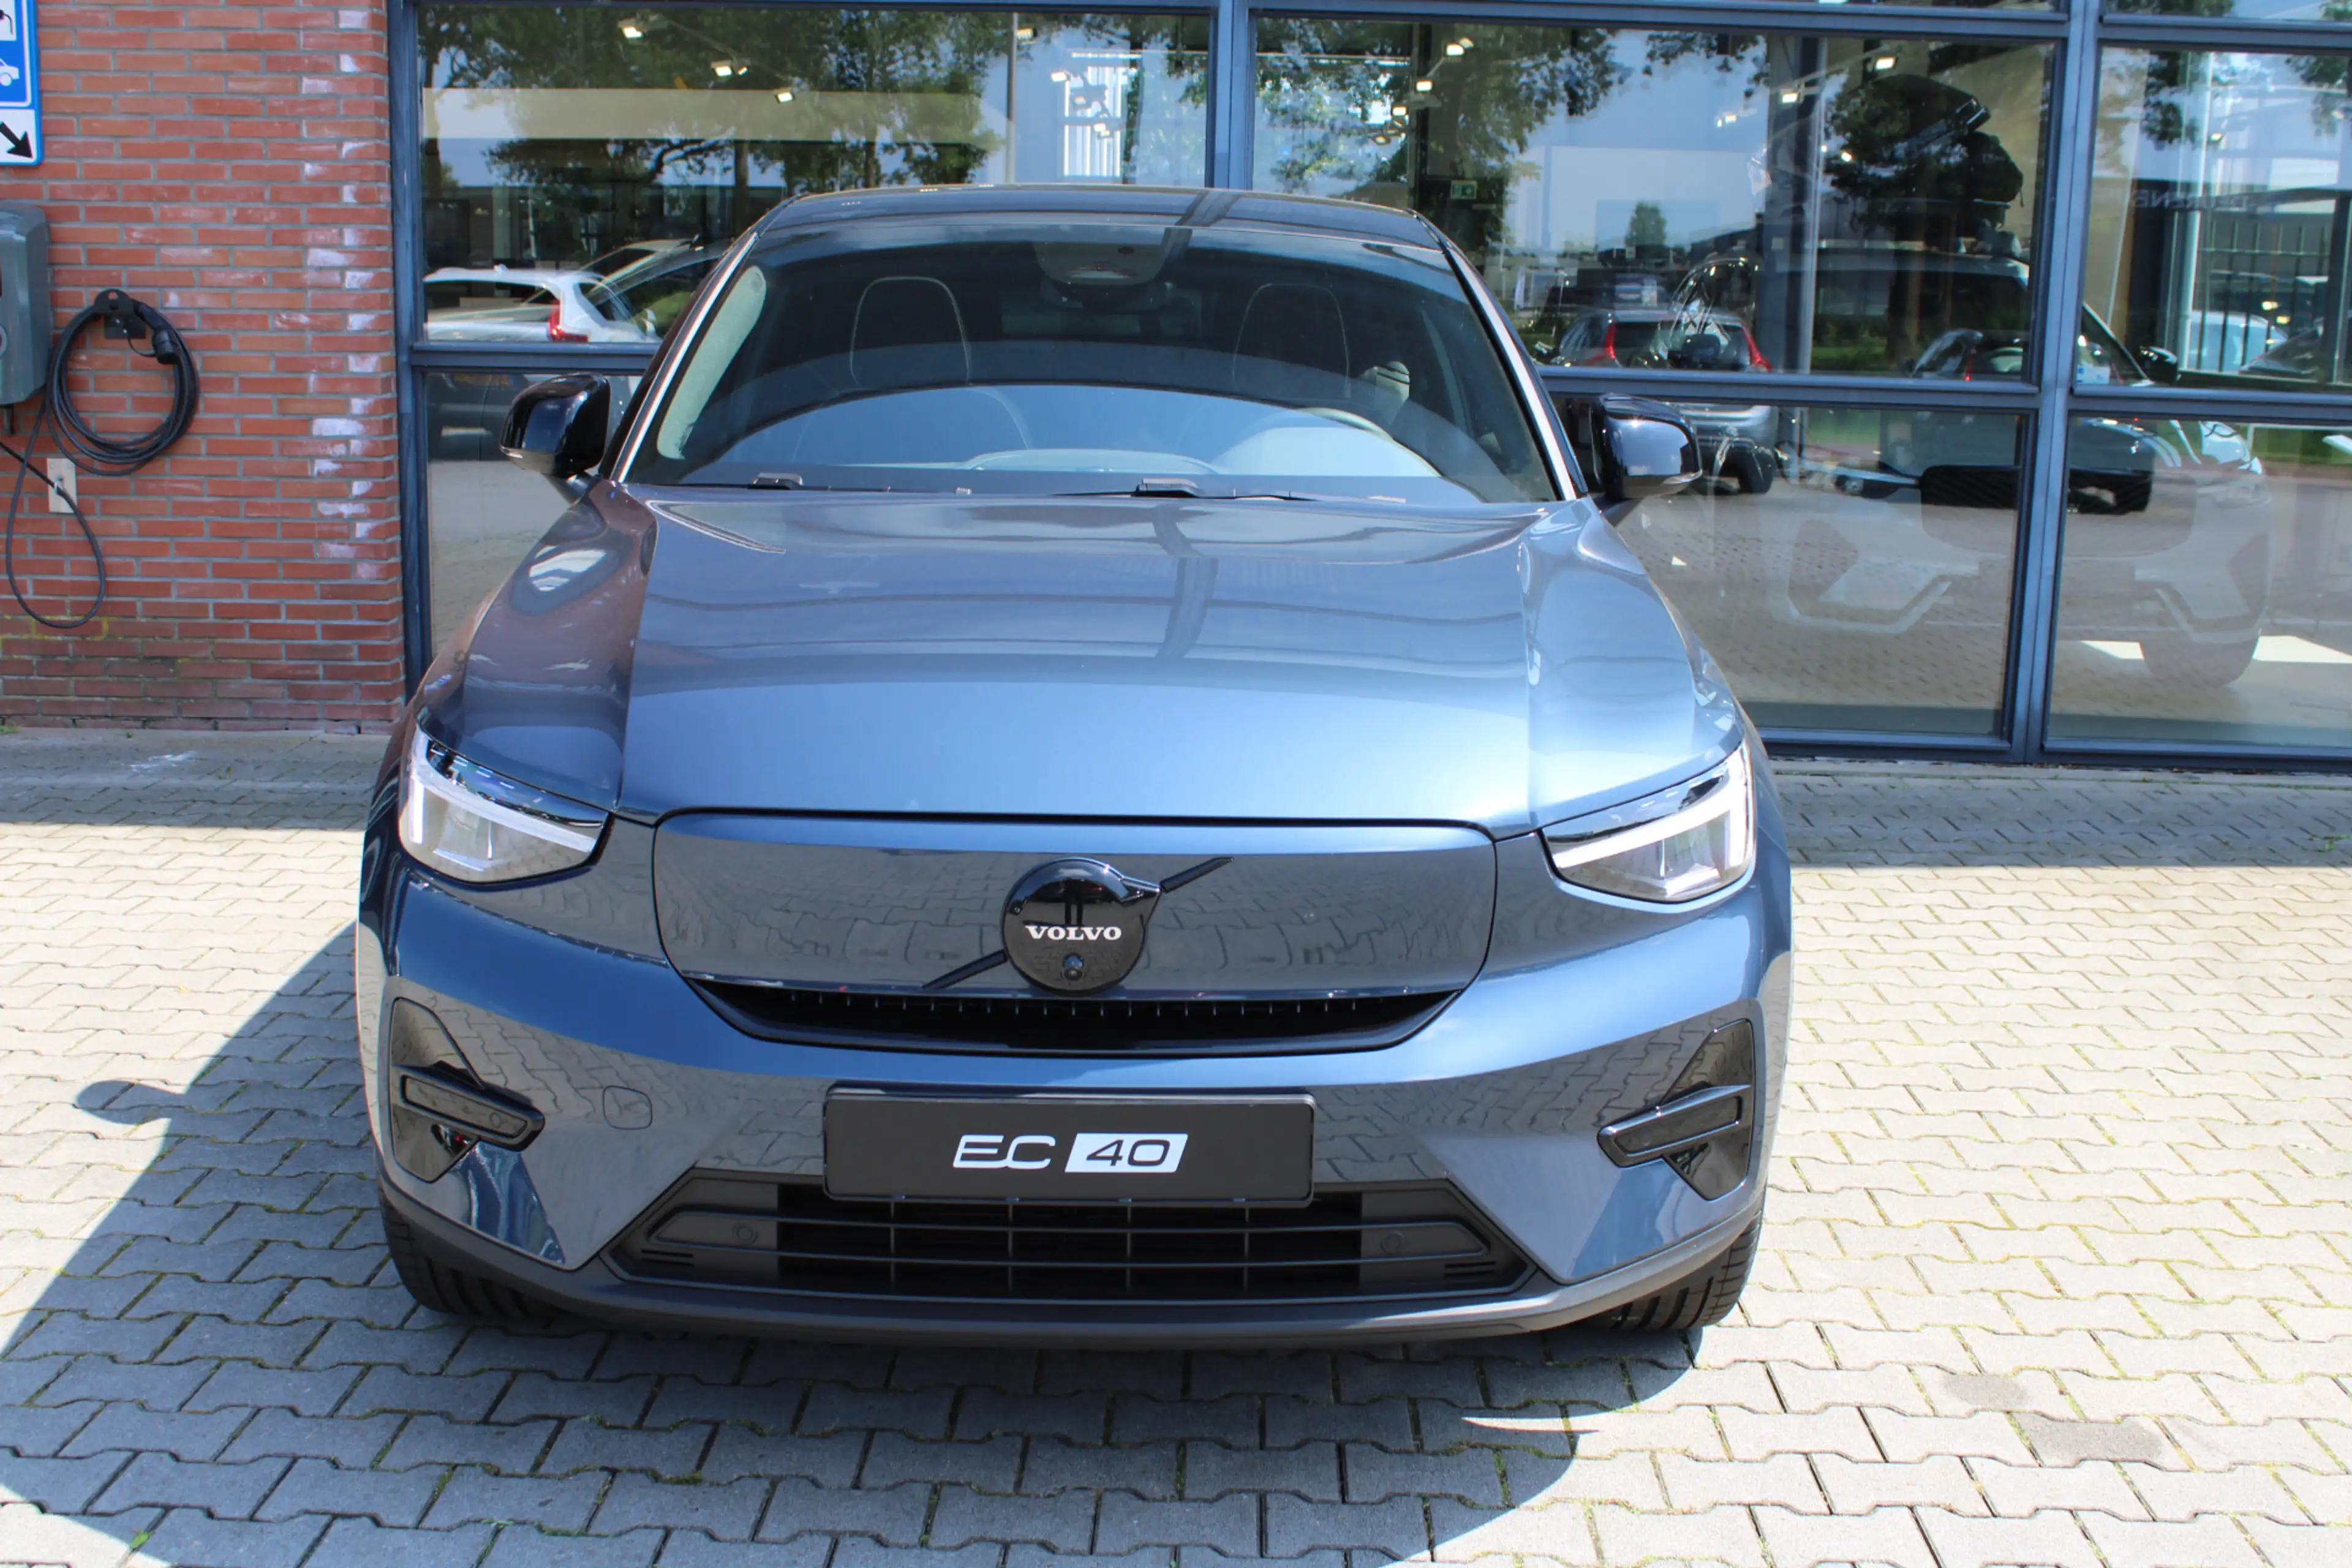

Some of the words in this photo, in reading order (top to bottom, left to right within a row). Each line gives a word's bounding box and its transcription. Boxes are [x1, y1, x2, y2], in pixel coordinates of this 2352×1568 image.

[1025, 925, 1122, 941] VOLVO
[953, 1135, 1056, 1169] EC
[1086, 1139, 1171, 1167] 40
